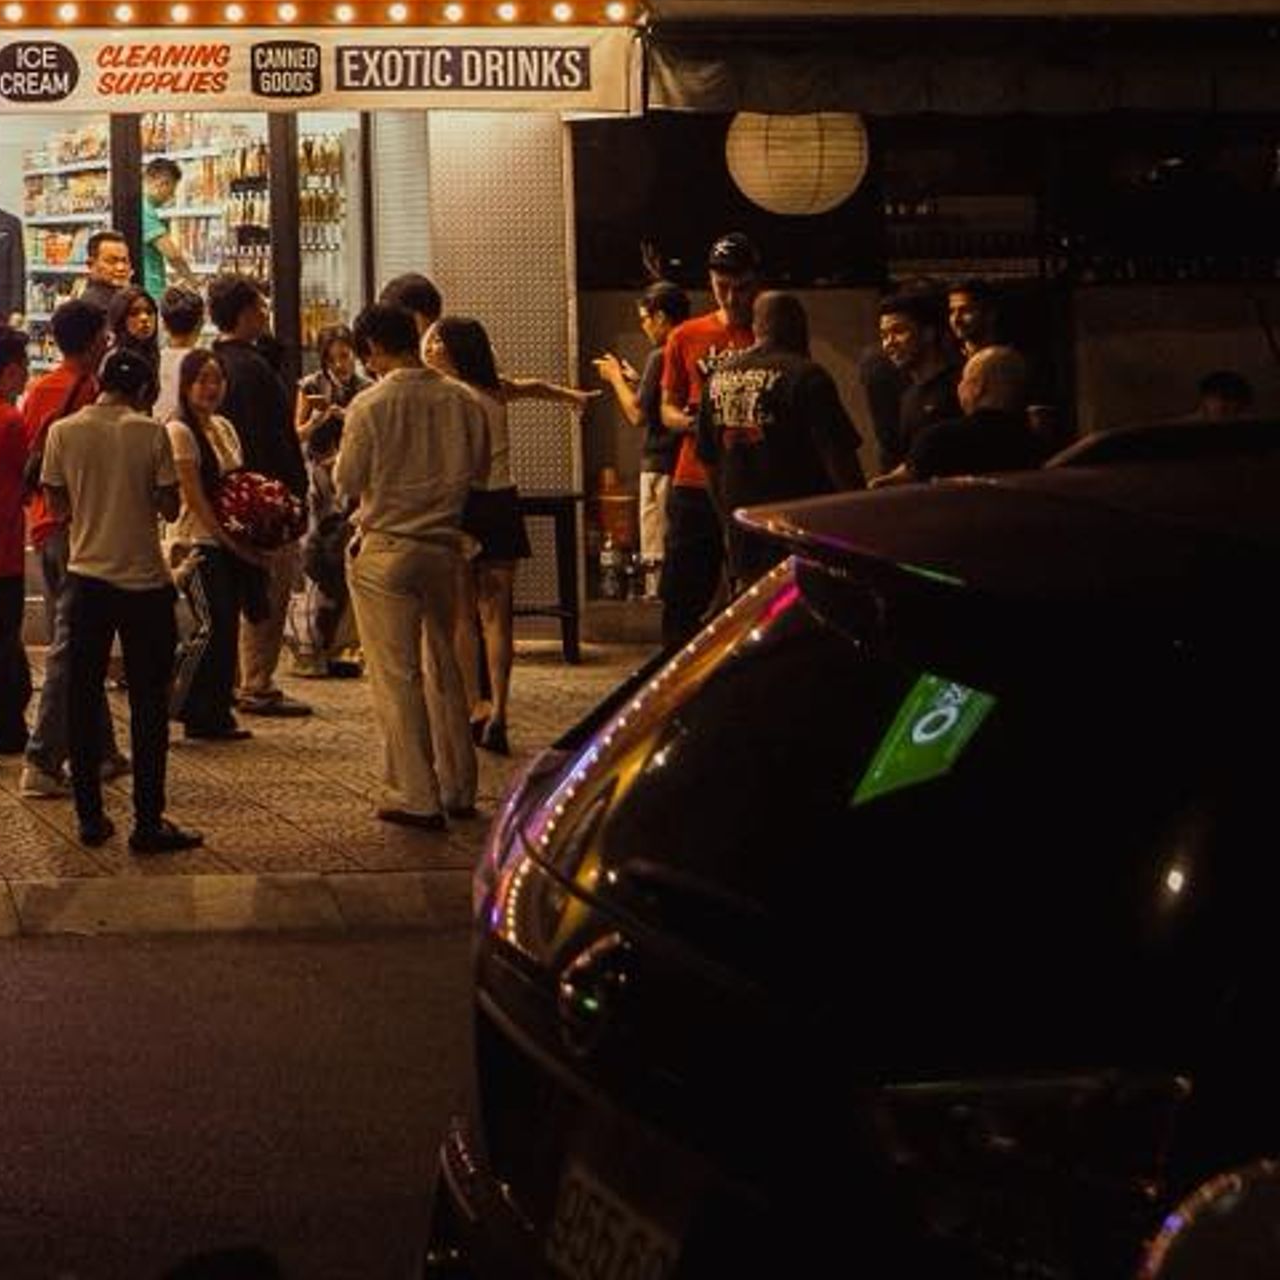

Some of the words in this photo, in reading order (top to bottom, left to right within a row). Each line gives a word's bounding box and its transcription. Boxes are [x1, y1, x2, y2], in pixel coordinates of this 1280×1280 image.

[16, 47, 58, 69] ICE
[97, 45, 231, 68] CLEANING
[254, 47, 318, 70] CANNED
[343, 49, 452, 88] EXOTIC
[461, 49, 582, 88] DRINKS
[0, 73, 69, 96] CREAM
[97, 72, 228, 96] SUPPLIES
[260, 71, 315, 94] GOODS
